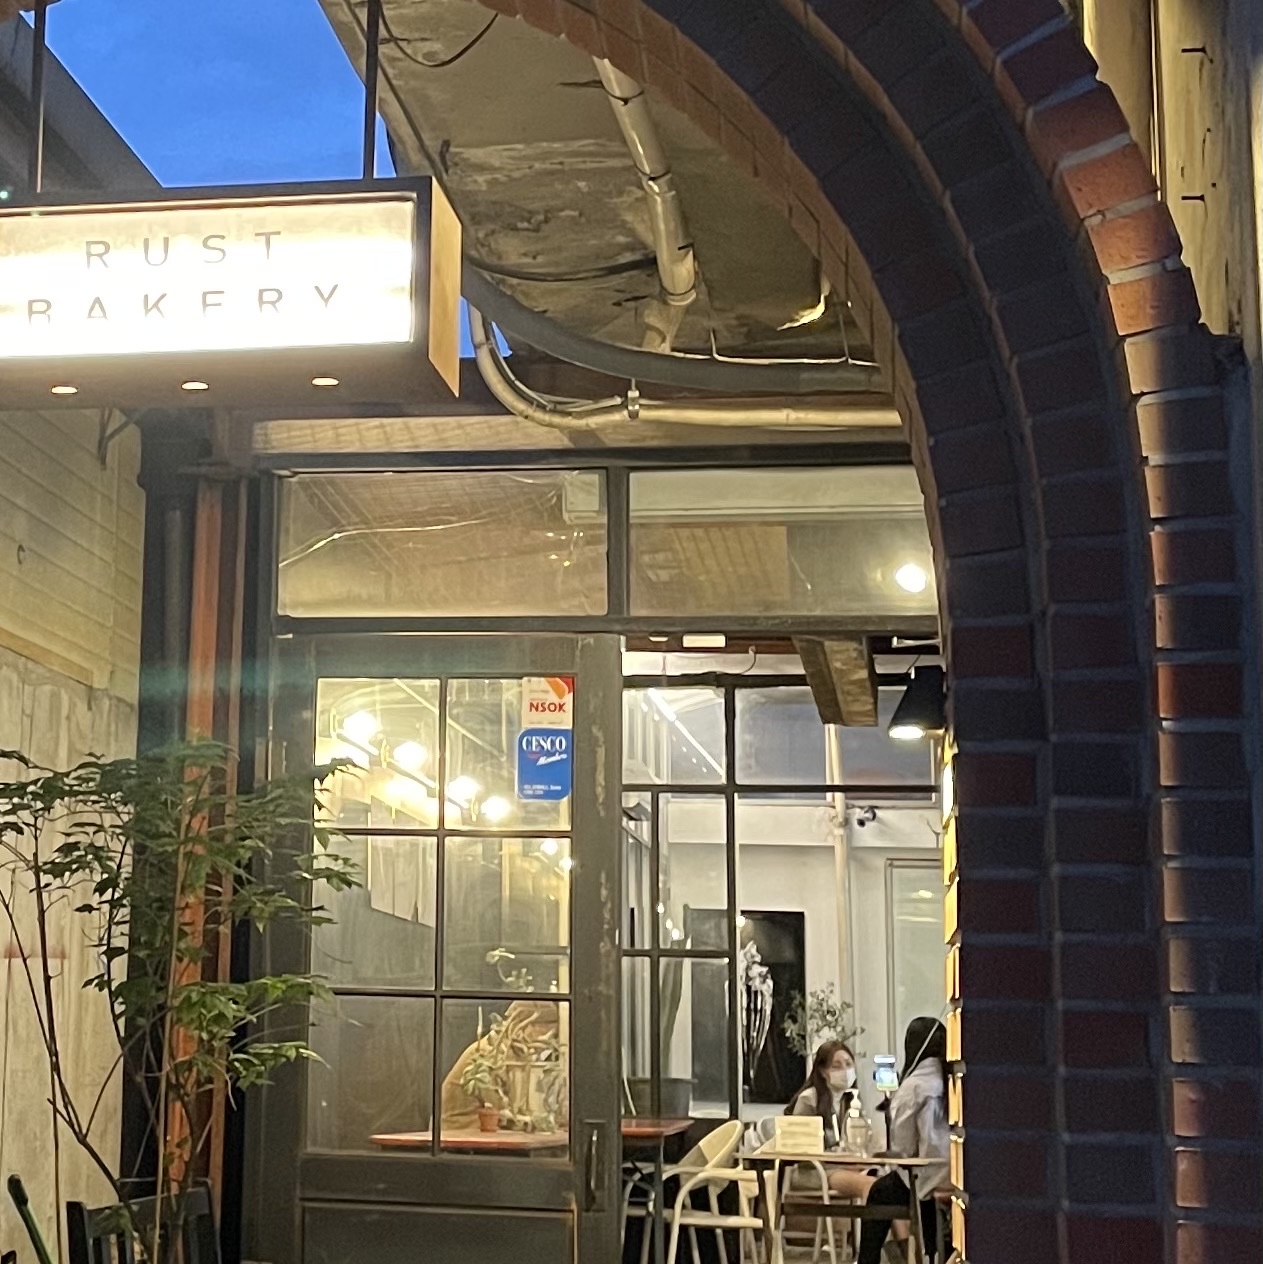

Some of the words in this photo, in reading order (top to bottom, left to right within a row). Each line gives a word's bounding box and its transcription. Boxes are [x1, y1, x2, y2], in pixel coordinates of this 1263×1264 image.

[84, 230, 282, 270] RUST
[26, 283, 340, 326] BAKERY
[529, 702, 566, 713] NSOK
[522, 735, 567, 752] CESCO
